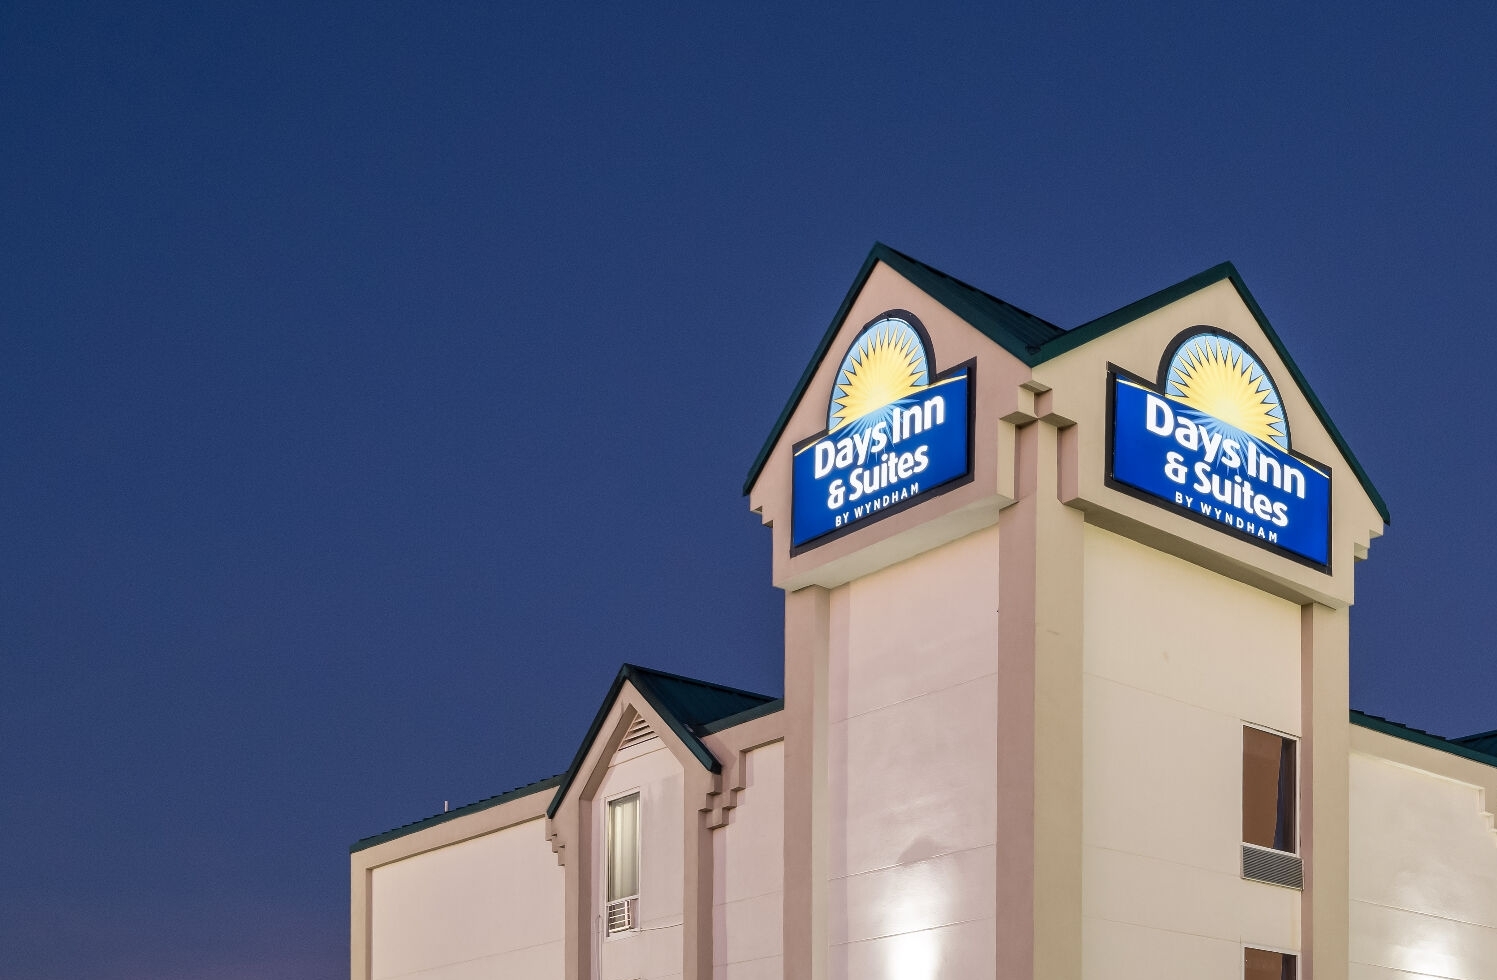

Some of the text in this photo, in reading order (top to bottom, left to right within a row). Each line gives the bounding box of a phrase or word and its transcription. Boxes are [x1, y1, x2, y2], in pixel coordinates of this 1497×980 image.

[814, 395, 945, 480] Days Inn
[1146, 394, 1306, 499] Days Inn
[827, 445, 929, 510] & Suites
[835, 482, 919, 527] BY WYNDHAM
[1164, 451, 1289, 527] & Suites
[1175, 491, 1278, 544] BY WYNDHAM
